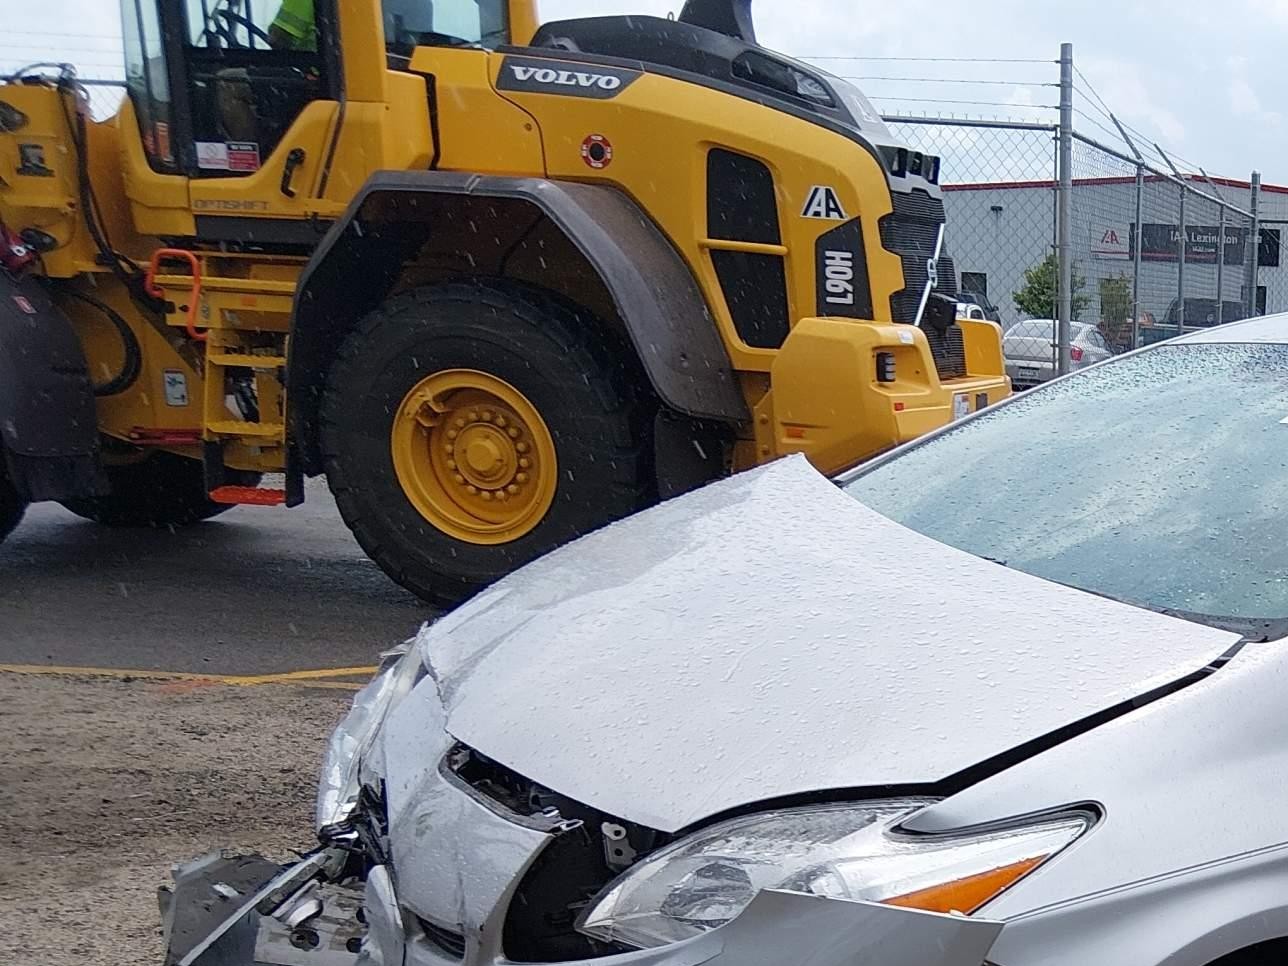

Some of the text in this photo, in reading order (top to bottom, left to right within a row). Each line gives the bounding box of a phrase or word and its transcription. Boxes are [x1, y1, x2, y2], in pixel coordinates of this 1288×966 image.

[510, 65, 621, 90] VOLVO
[1191, 231, 1238, 245] Lexinton
[824, 250, 854, 305] L90H
